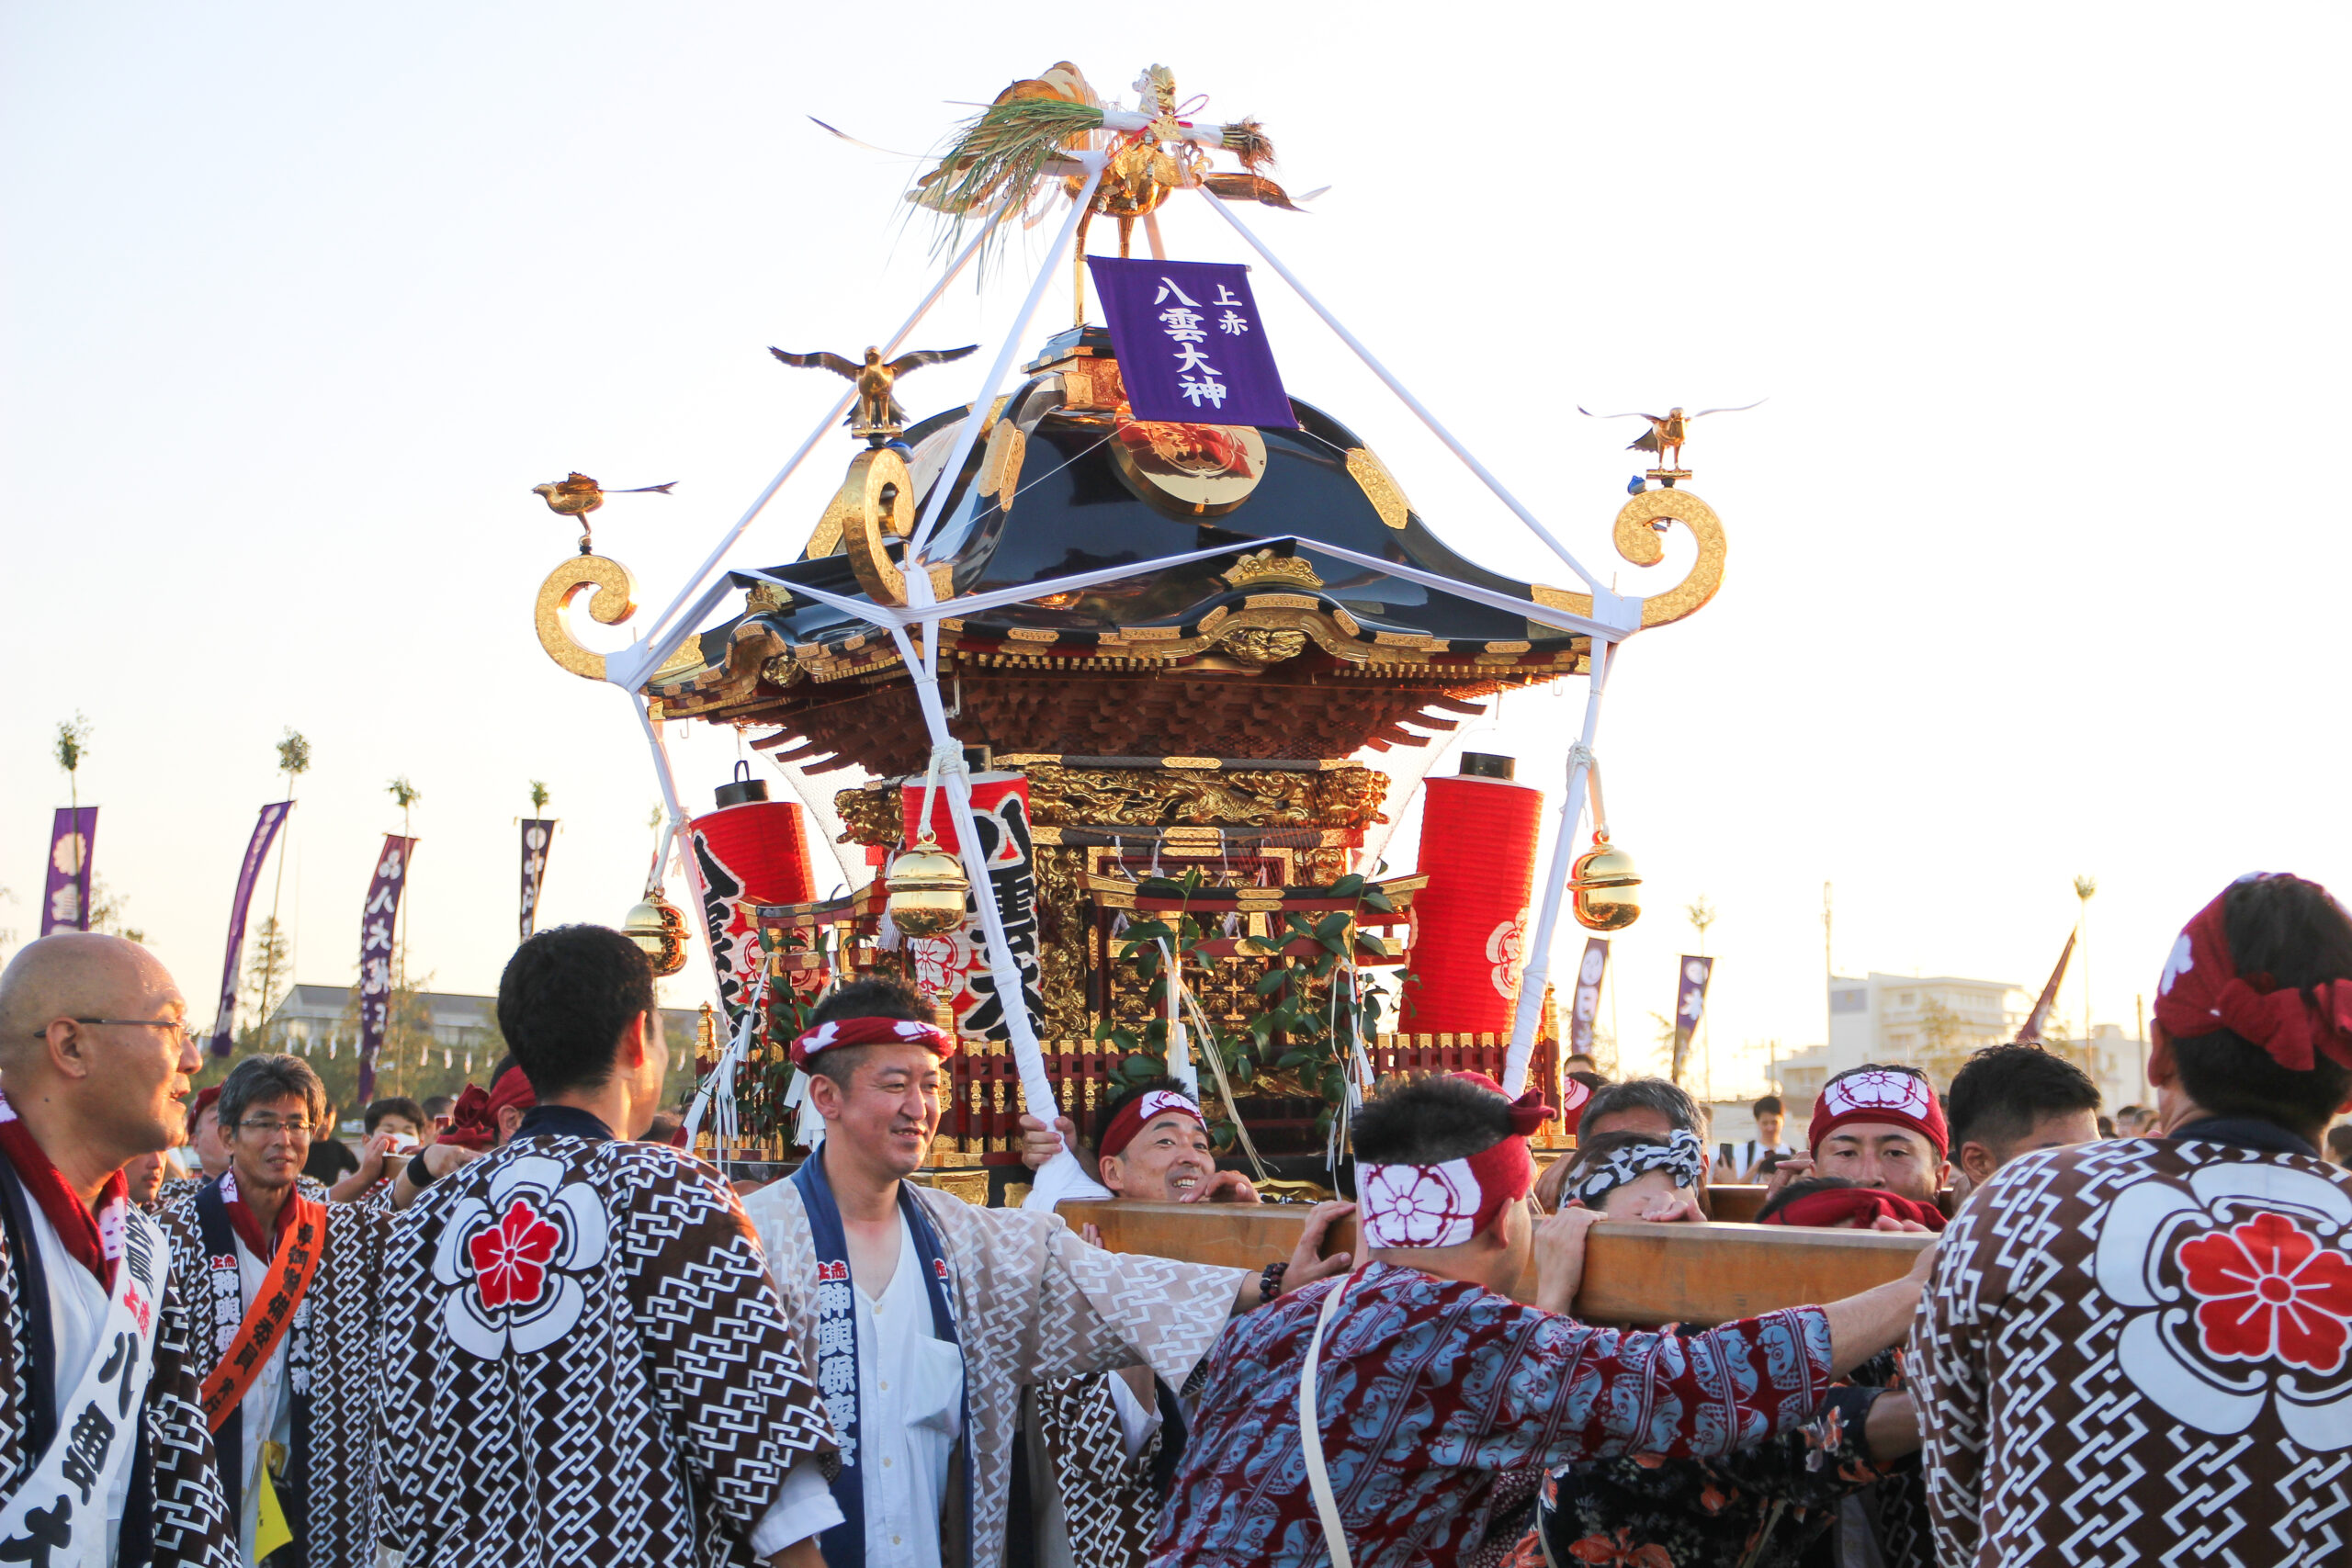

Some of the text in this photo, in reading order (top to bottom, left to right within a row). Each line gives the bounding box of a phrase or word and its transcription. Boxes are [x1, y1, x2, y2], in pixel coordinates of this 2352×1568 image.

[1154, 276, 1227, 410] 八雲大神
[1213, 284, 1249, 336] 上赤
[963, 798, 1045, 1042] 八雲大
[210, 1255, 237, 1271] 上赤
[818, 1260, 848, 1281] 上赤
[933, 1258, 949, 1280] 赤
[211, 1270, 243, 1366] 神輿保
[288, 1297, 312, 1396] 雲大神
